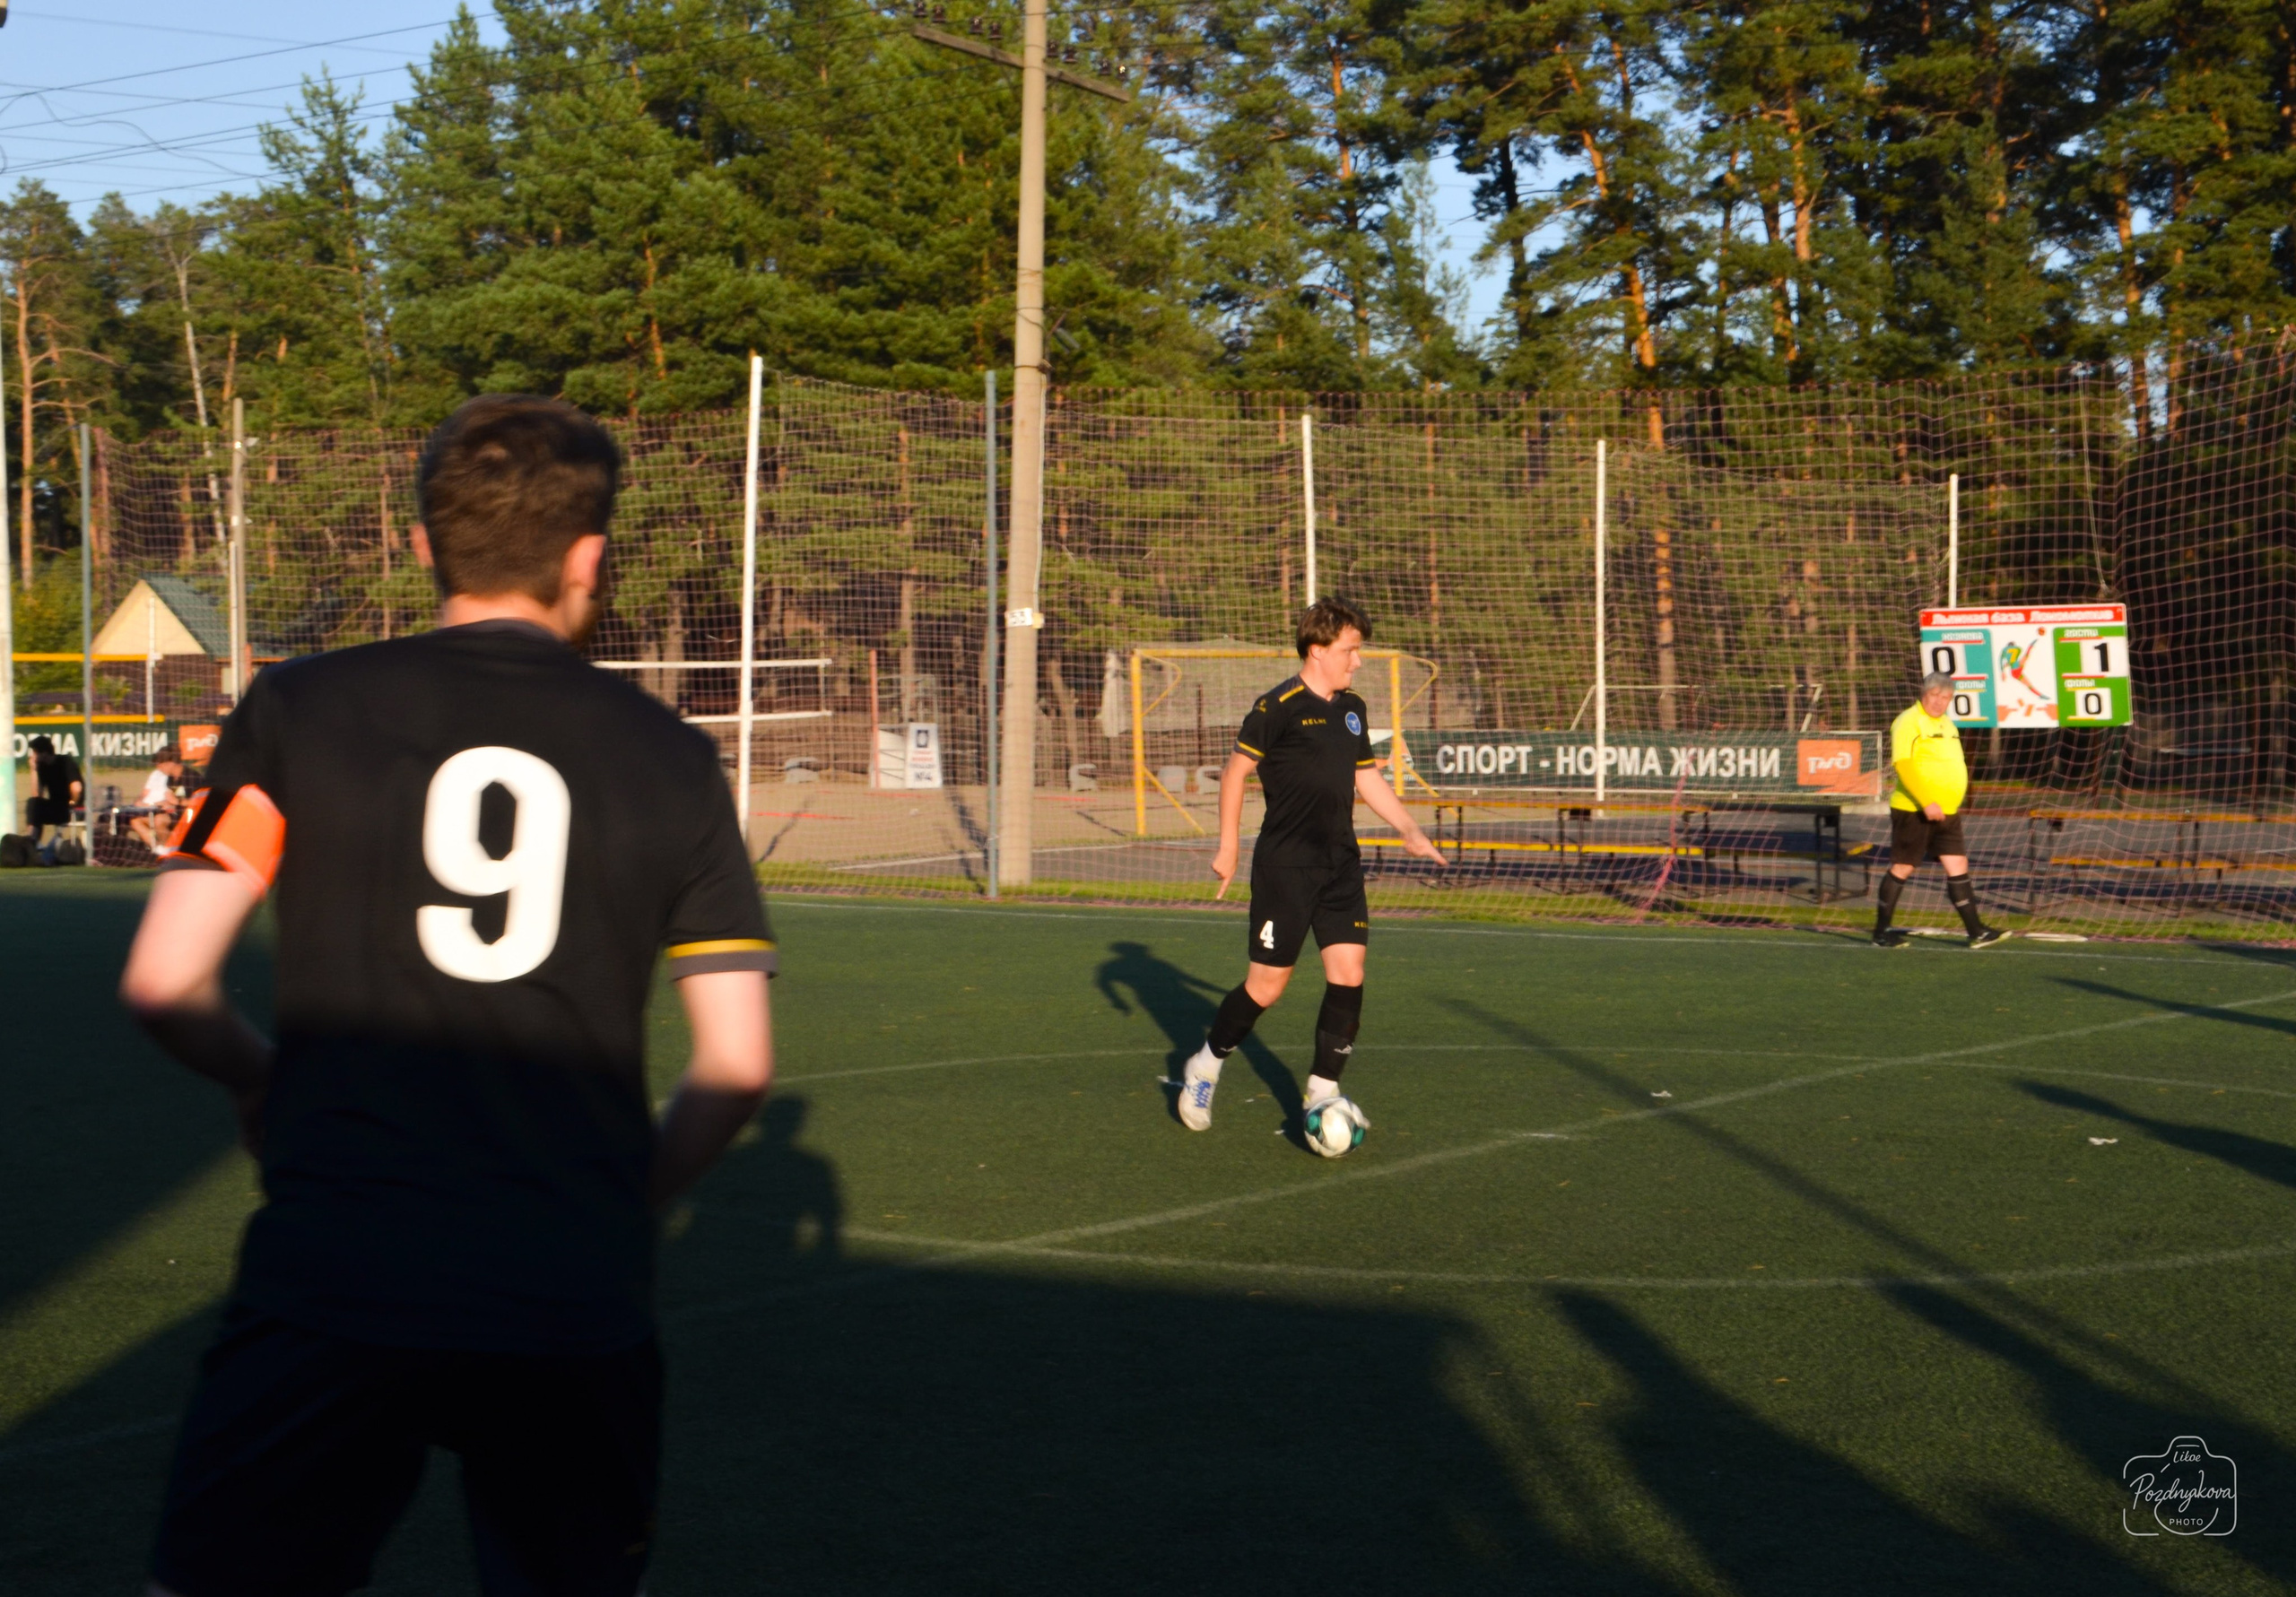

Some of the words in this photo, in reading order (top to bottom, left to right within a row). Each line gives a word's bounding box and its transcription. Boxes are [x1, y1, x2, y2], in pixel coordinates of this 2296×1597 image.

[1932, 647, 1955, 674] 0
[2093, 643, 2109, 673] 1
[1954, 694, 1970, 716] 0
[2084, 693, 2101, 715] 0
[1436, 745, 1533, 774] СПОРТ
[1556, 746, 1663, 776] НОРМА
[1670, 747, 1780, 777] ЖИЗНИ
[416, 746, 570, 983] 9
[1259, 920, 1274, 949] 4
